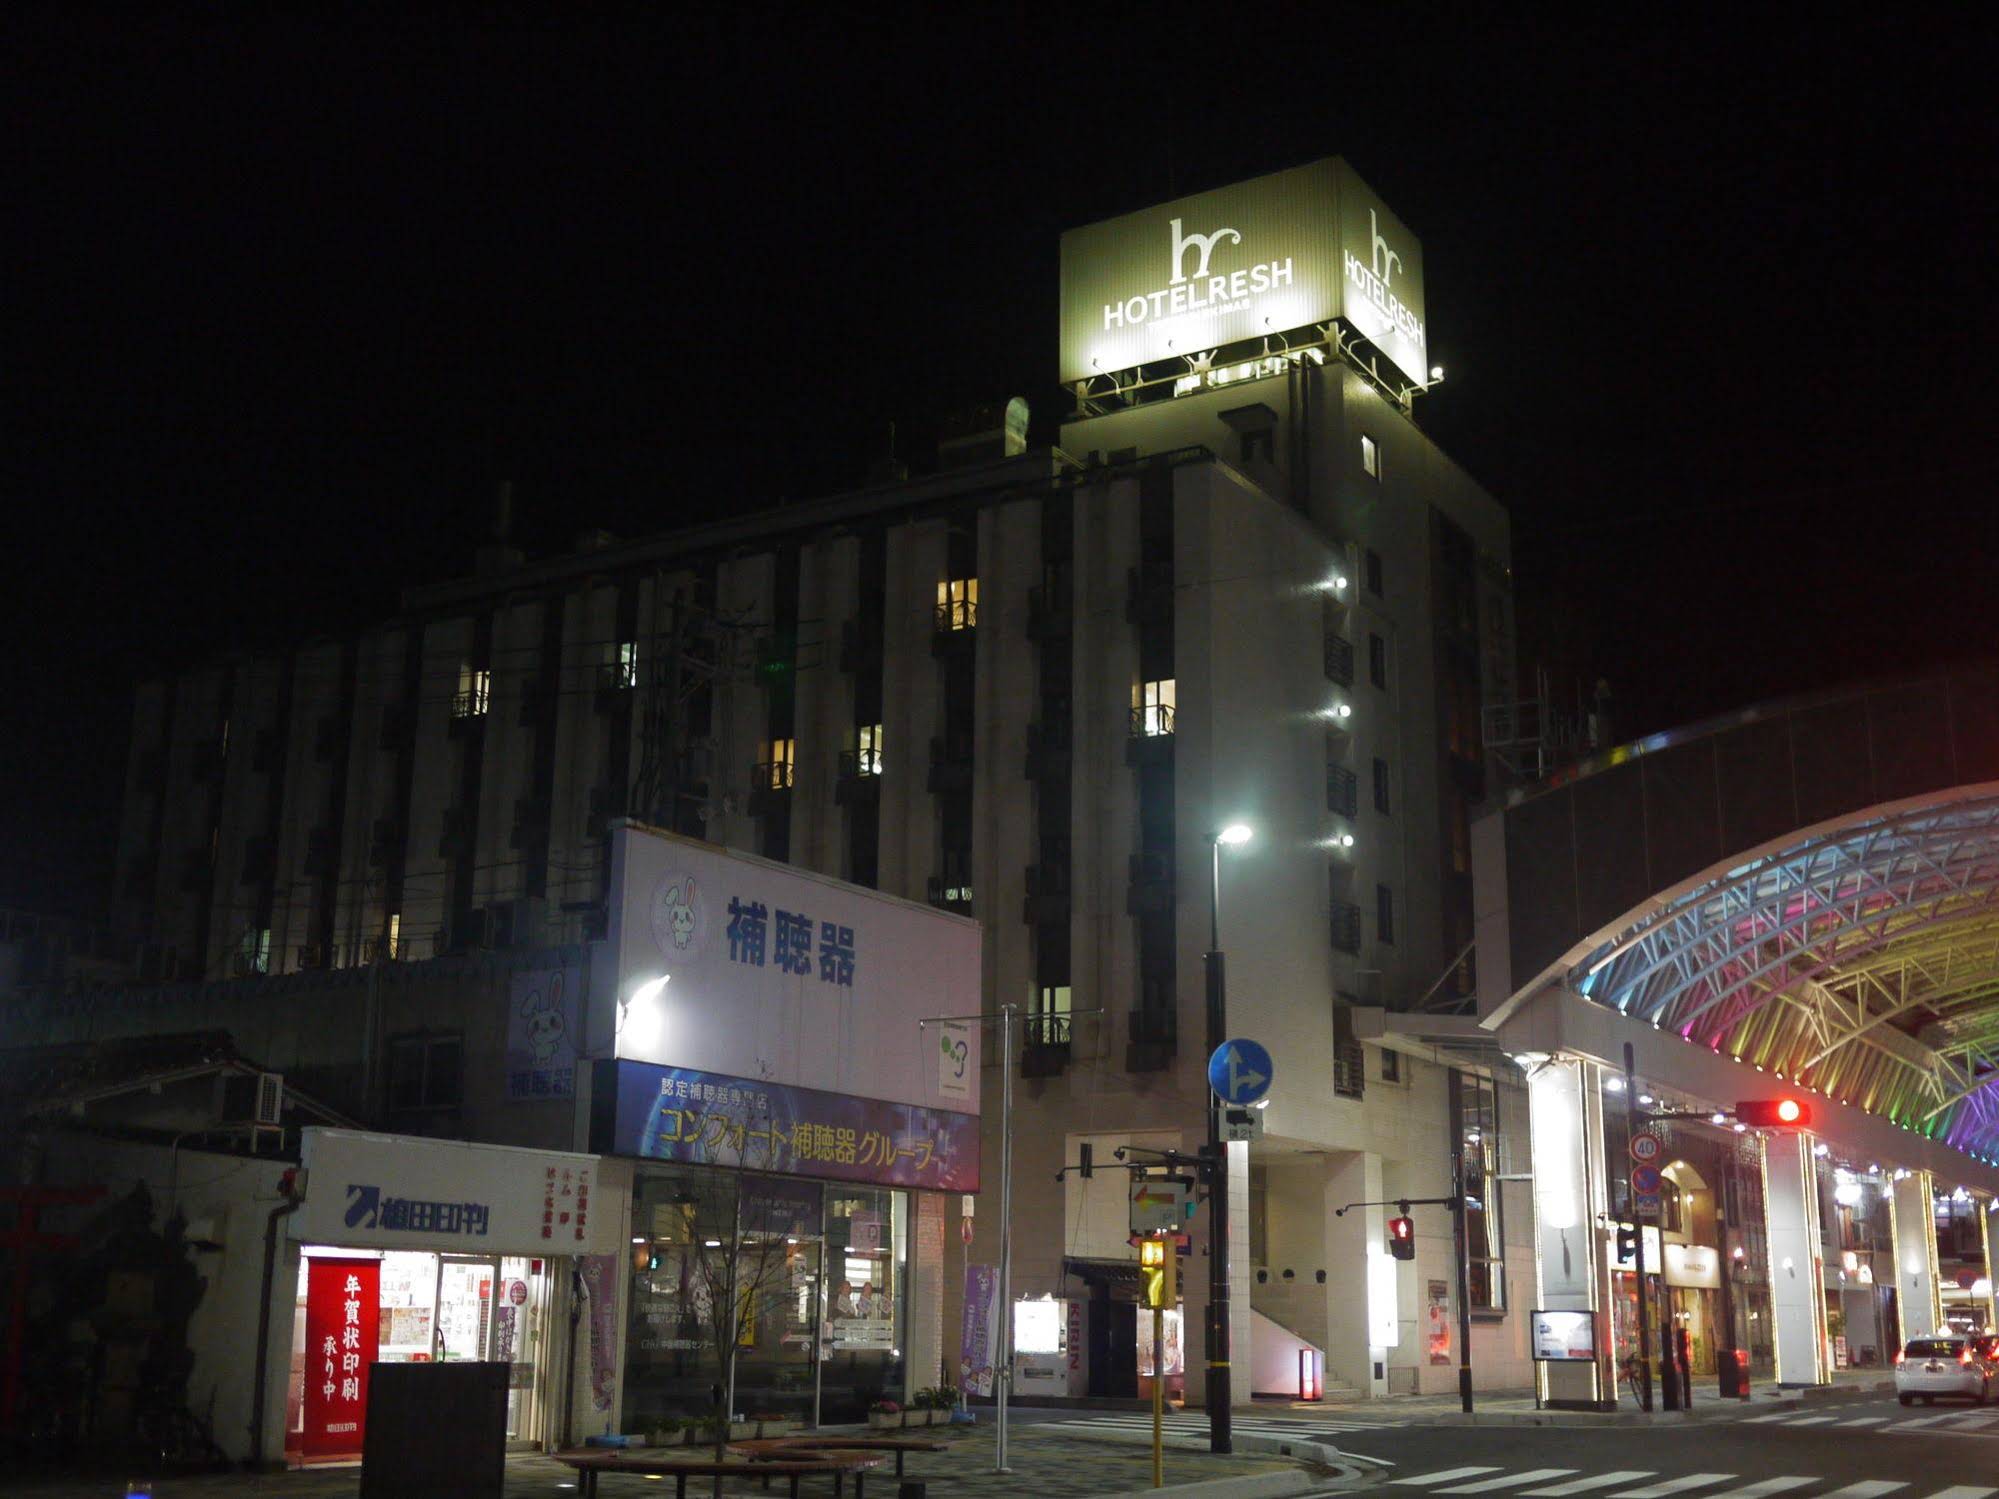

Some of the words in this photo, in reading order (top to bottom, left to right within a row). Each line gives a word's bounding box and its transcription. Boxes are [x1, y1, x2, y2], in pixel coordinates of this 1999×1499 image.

[727, 896, 856, 987] 補聴器
[661, 1077, 769, 1110] 認定補聴器専門店
[1638, 1141, 1654, 1154] 40
[322, 1335, 338, 1403] 承り中
[342, 1273, 362, 1403] 年賀状印刷
[1069, 1303, 1081, 1371] KIRIN
